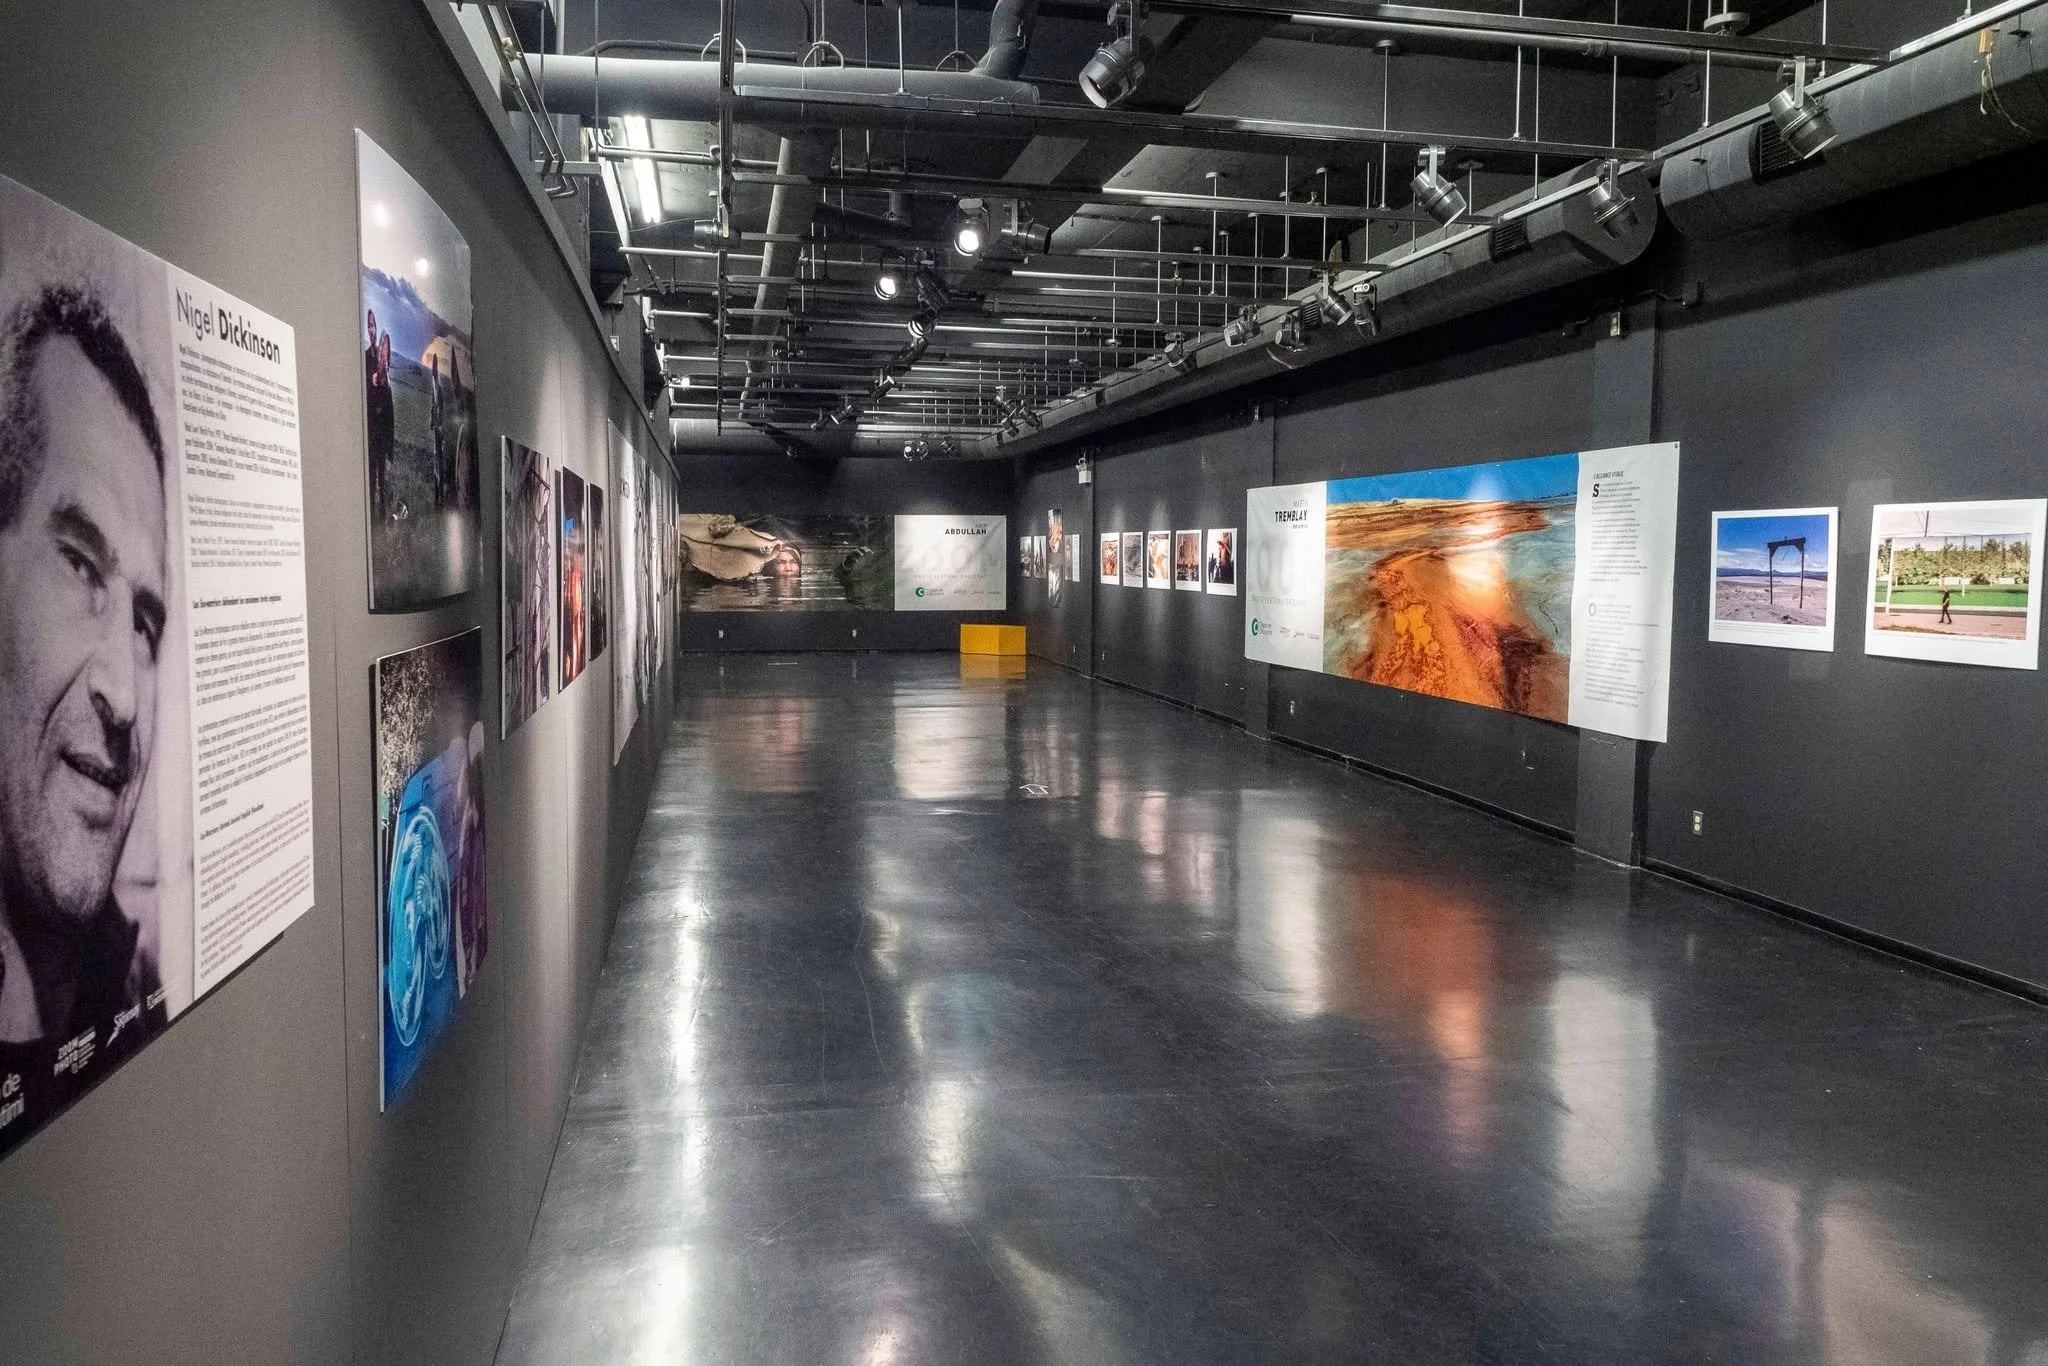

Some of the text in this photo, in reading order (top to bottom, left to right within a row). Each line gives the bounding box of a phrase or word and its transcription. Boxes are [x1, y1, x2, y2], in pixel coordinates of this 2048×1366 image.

[176, 288, 281, 365] Nigel Dickinson
[1275, 509, 1308, 522] TREMBLAY
[2, 1073, 21, 1098] de
